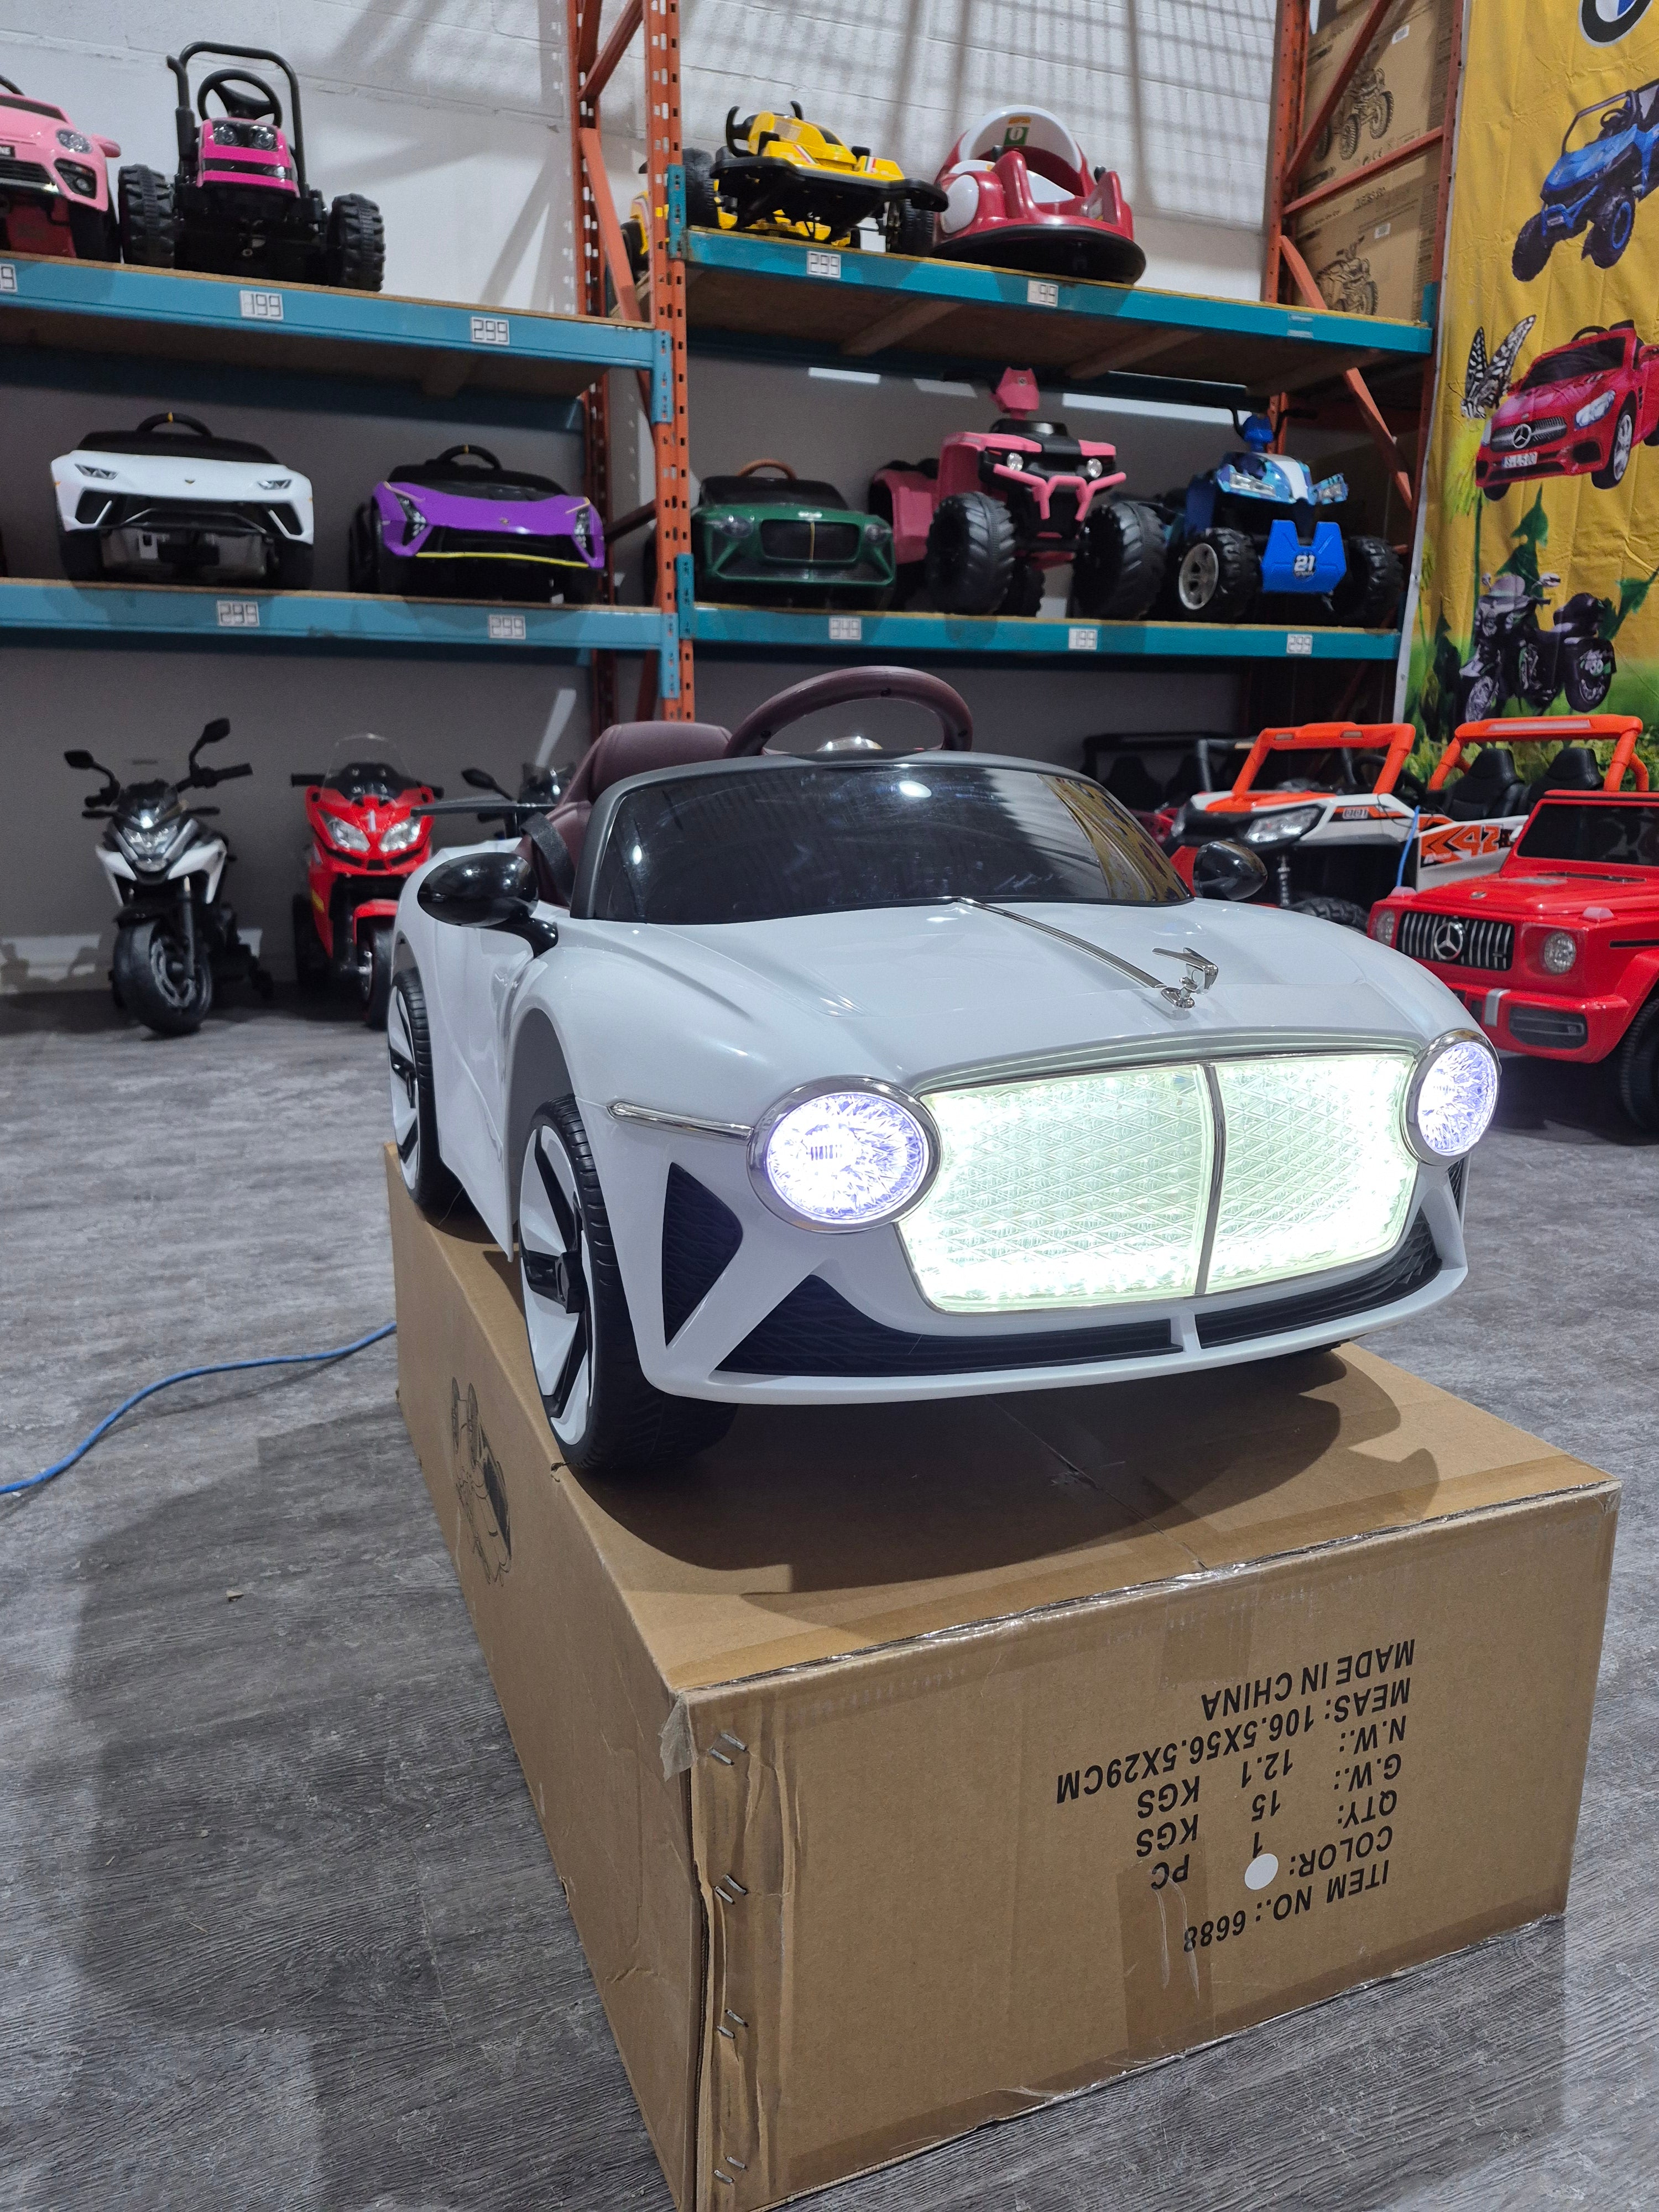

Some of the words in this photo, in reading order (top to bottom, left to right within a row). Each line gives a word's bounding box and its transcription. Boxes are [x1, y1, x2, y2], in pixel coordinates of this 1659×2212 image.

[0, 266, 15, 290] 9
[810, 253, 839, 275] 299
[250, 293, 281, 317] 199
[473, 319, 508, 342] 299
[1294, 555, 1315, 571] 21
[220, 602, 258, 625] 299
[491, 615, 525, 638] 299
[1288, 636, 1312, 653] 299
[1301, 1662, 1328, 1695] IN
[1336, 1639, 1415, 1685] MADE
[1202, 1672, 1292, 1720] CHINA
[1325, 1678, 1410, 1723] MEAS:
[1340, 1715, 1406, 1755] N.W.:
[1057, 1705, 1313, 1804] 106.5X56.5X29CM
[1241, 1749, 1292, 1788] 12.1
[1334, 1754, 1401, 1792] G.W.:
[1138, 1776, 1199, 1818] KGS
[1251, 1790, 1280, 1822] 15
[1338, 1790, 1397, 1829] QTY:
[1136, 1814, 1198, 1857] KGS
[1253, 1832, 1263, 1859] 1
[1290, 1826, 1392, 1877] COLOR:
[1150, 1854, 1190, 1890] PC
[1327, 1860, 1389, 1903] ITEM
[1256, 1886, 1312, 1922] NO.:
[1183, 1910, 1246, 1953] 6688
